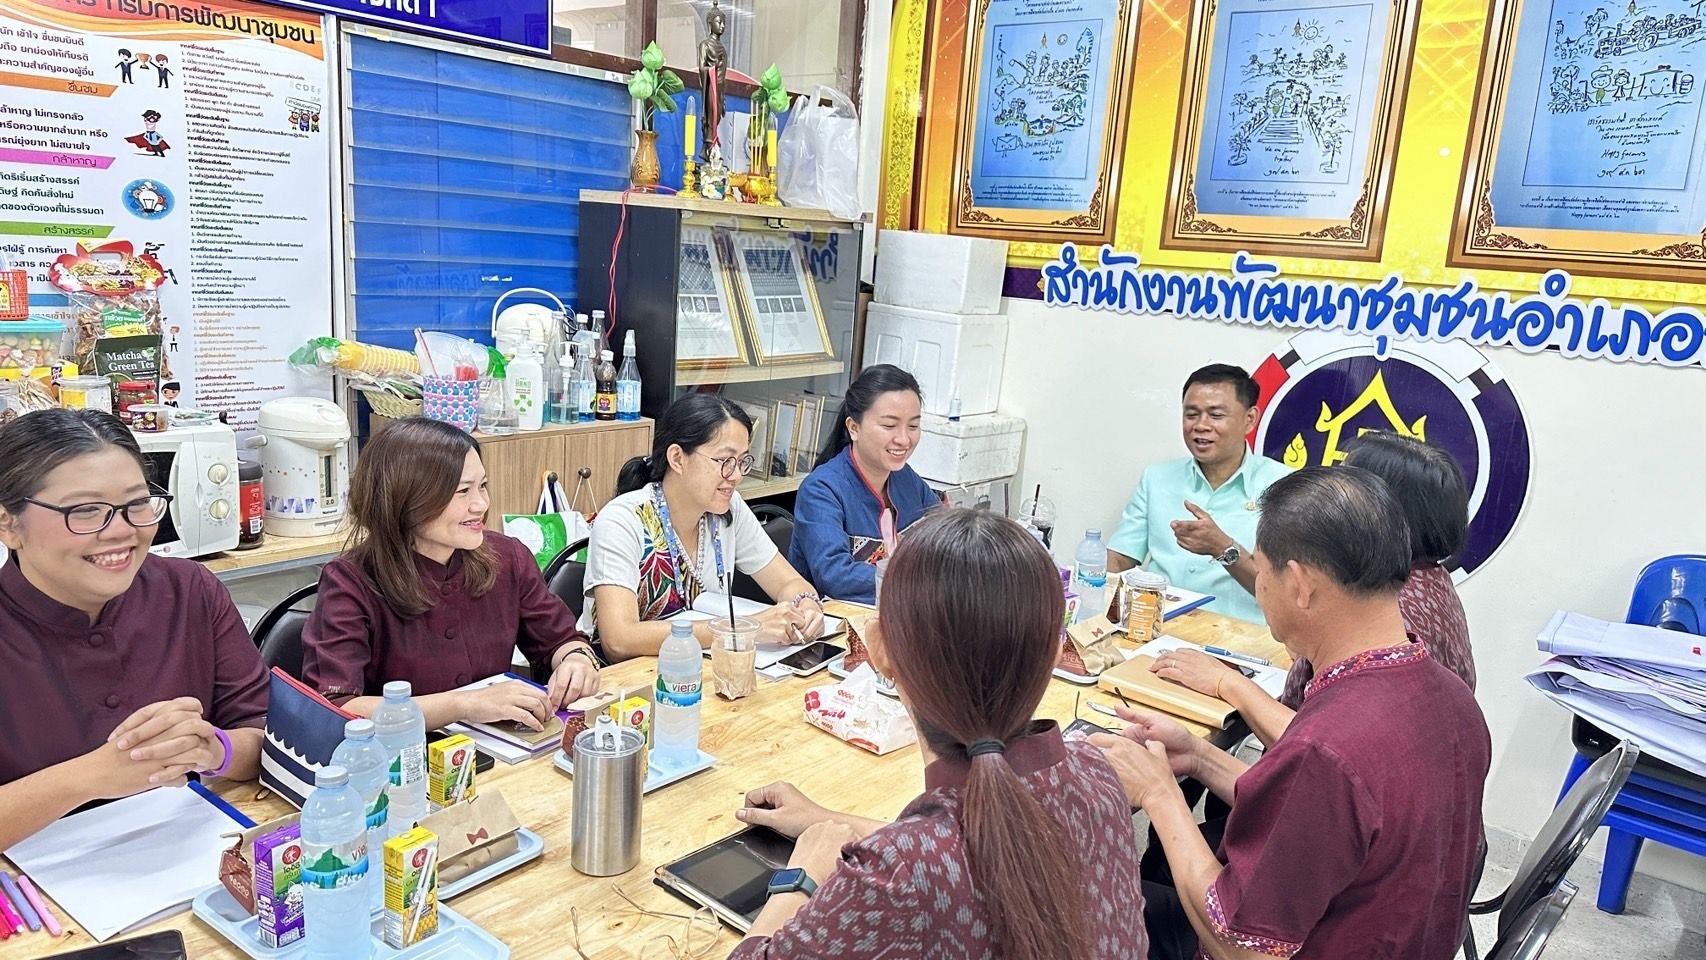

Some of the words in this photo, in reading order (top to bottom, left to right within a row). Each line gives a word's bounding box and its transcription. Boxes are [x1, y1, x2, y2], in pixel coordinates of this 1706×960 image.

[106, 0, 317, 44] กรมการพัฒนาชุมชน
[17, 29, 38, 40] เข้าใจ
[42, 31, 85, 46] ชื่นชมยินดี
[20, 46, 89, 61] ยกย่องให้เกียรติ
[68, 81, 98, 94] ชื่นชม
[35, 107, 84, 121] ไม่เกรงกลัว
[90, 129, 108, 139] หรือ
[50, 139, 91, 151] ไม่สบายใจ
[52, 154, 97, 167] กล้าหาญ
[21, 188, 74, 199] คิดค้นสิ่งใหม่
[0, 203, 104, 215] ดของตัวเองที่ไม่ธรรมดา
[43, 225, 95, 236] สร้างสรรค์
[28, 245, 68, 254] การค้นหา
[1045, 246, 1704, 361] สำนักงานพัฒนาชุมชนอำเภอ
[106, 350, 143, 361] Matcha
[108, 361, 138, 371] Green
[138, 360, 155, 369] Tea
[672, 682, 697, 693] viera
